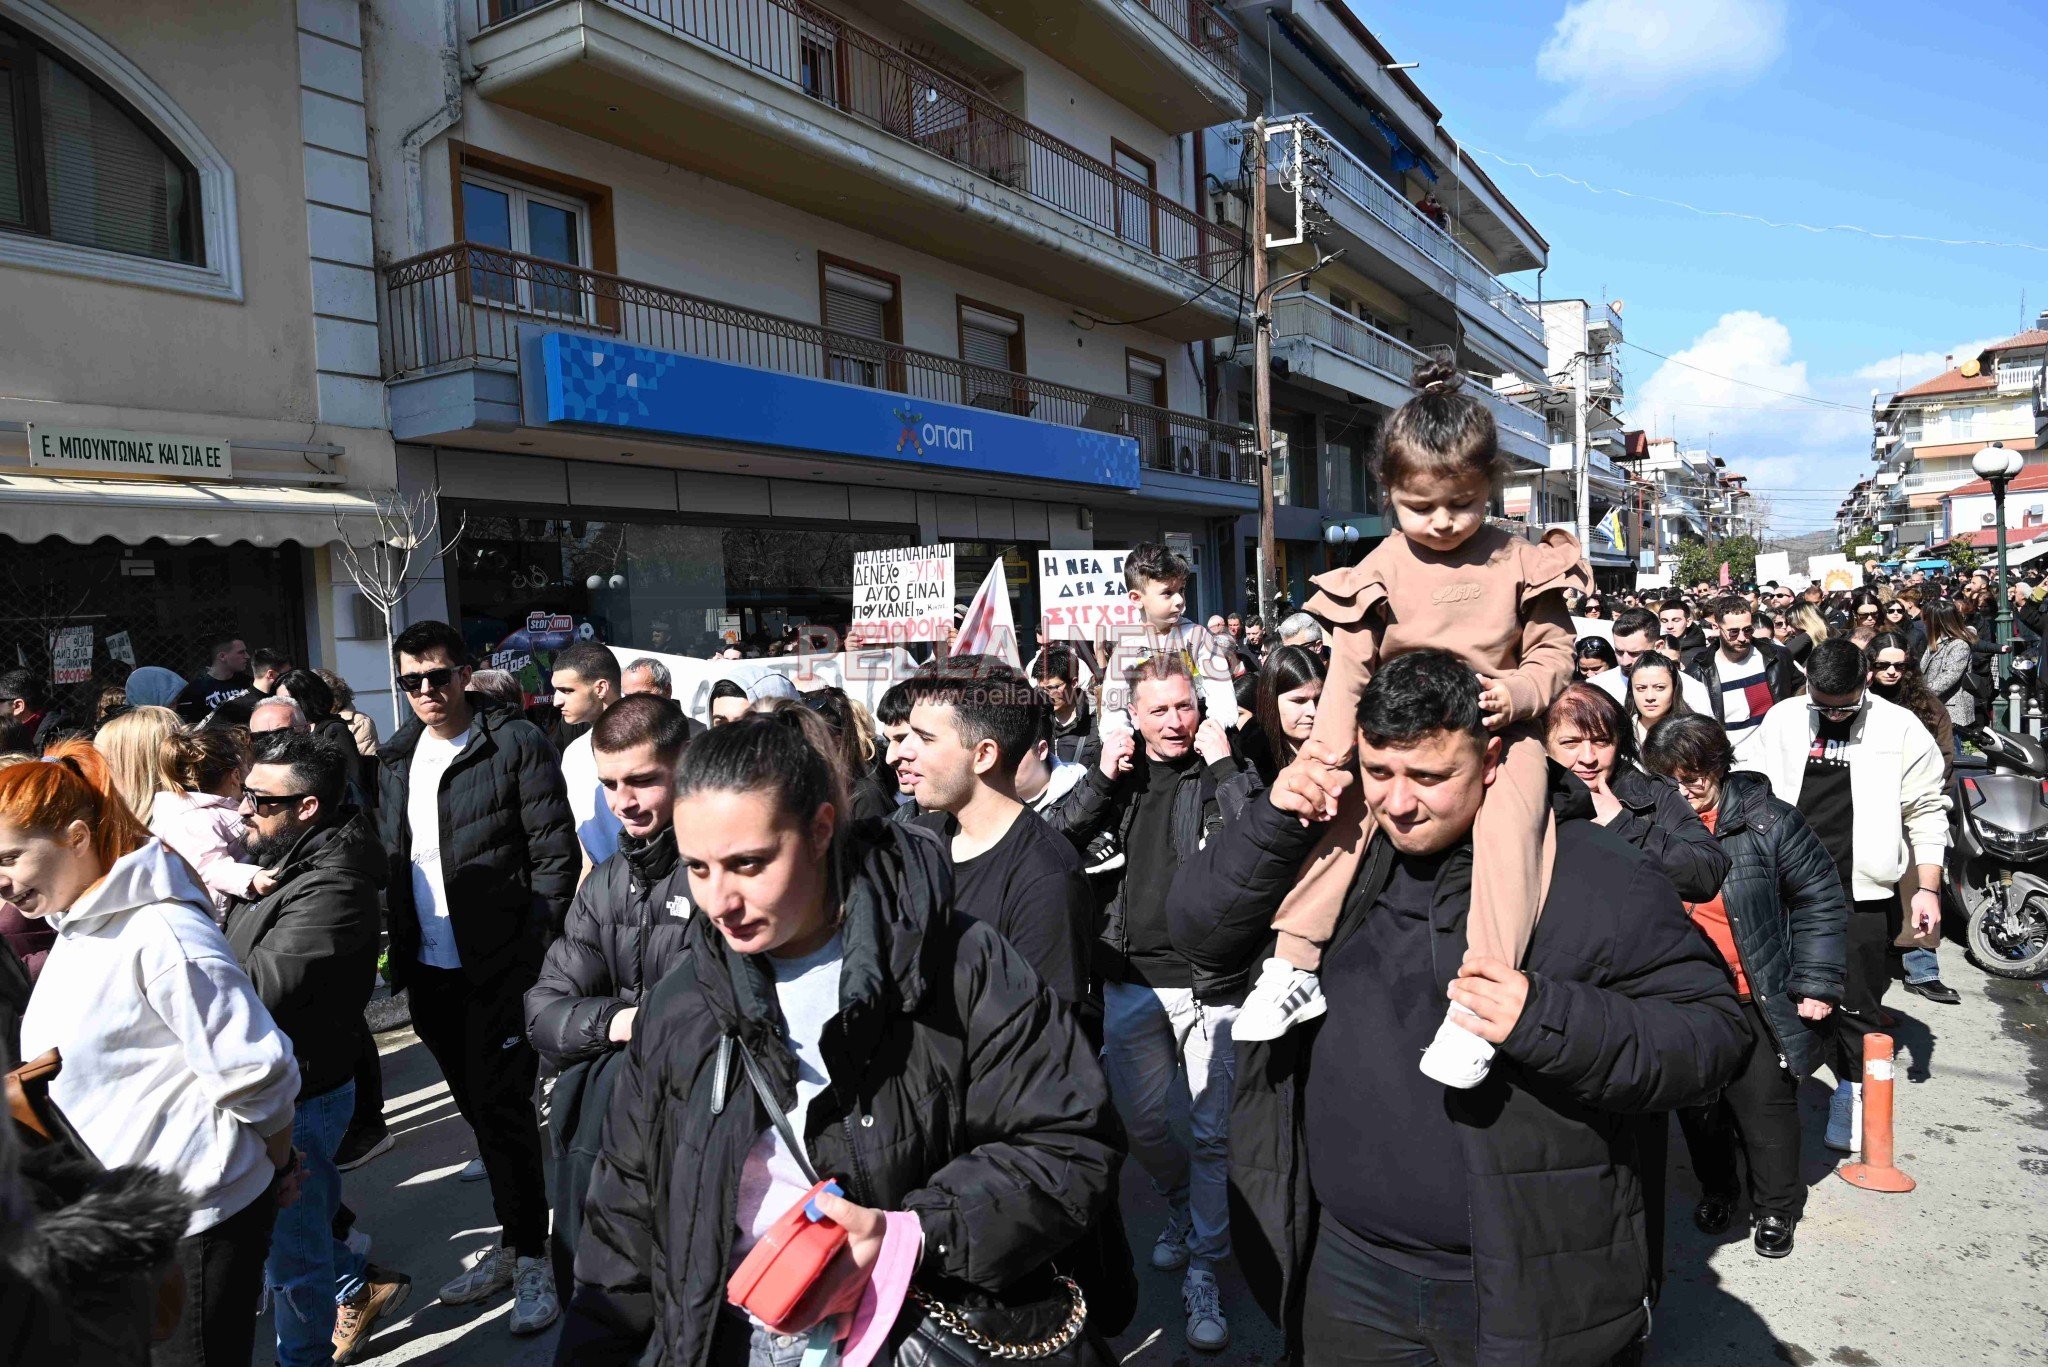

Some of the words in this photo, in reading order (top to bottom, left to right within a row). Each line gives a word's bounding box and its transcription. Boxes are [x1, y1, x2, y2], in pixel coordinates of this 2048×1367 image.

[41, 435, 56, 458] Ε.
[59, 436, 155, 464] ΜΠΟΥΝΤΩΝΑΣ
[158, 443, 179, 465] ΚΑΙ
[182, 445, 203, 467] ΣΙΑ
[206, 446, 222, 468] ΕΕ
[1044, 557, 1059, 577] Η
[1065, 558, 1103, 575] ΝΕΑ
[865, 586, 901, 603] ΑΥΤΟ
[906, 581, 945, 600] ΕΙΝΑΙ
[1058, 581, 1095, 598] ΔΕΝ
[1104, 580, 1128, 596] ΣΑ
[1045, 604, 1138, 625] ΣΥΓΧΩΡ
[491, 648, 515, 667] BET
